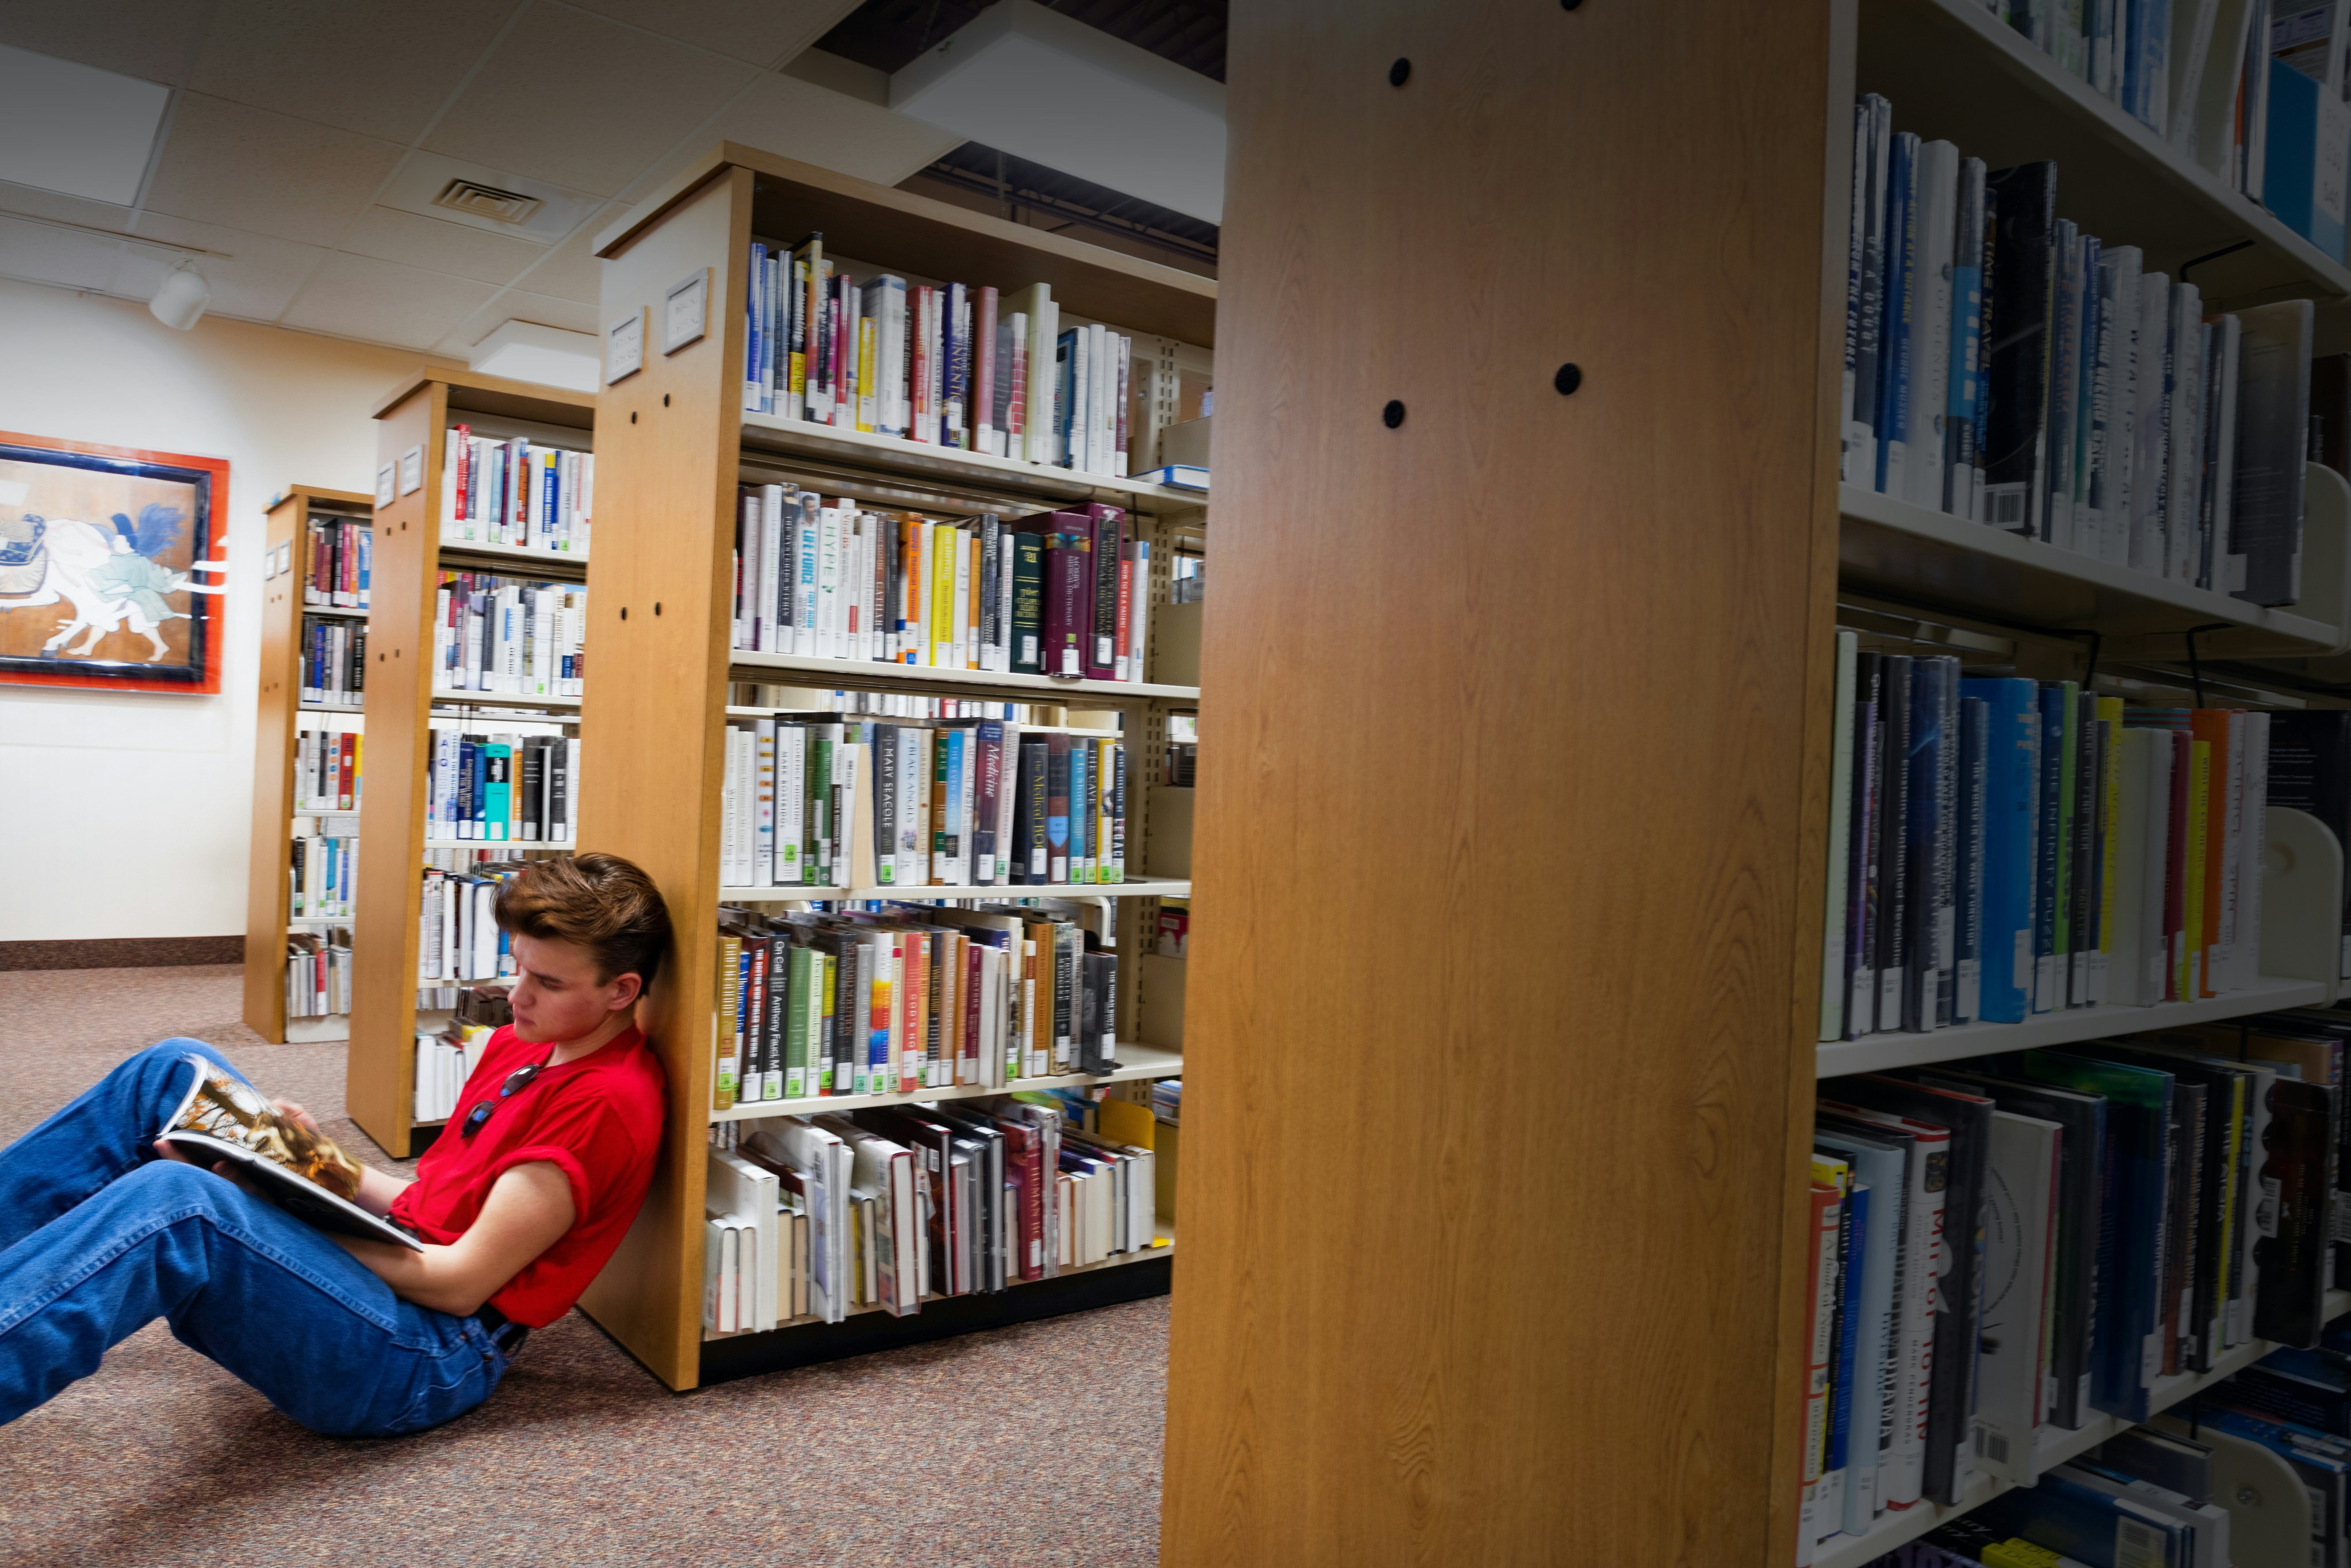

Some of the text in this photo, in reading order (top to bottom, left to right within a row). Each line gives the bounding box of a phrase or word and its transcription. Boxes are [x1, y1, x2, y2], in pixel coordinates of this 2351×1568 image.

[792, 292, 806, 343] Inventing
[1979, 296, 1994, 373] TRAVEL
[1897, 385, 1908, 429] MUSSER
[801, 530, 815, 585] LIFE FORCE
[824, 526, 837, 577] HYPE
[941, 546, 952, 580] thriving
[1073, 556, 1081, 589] MOSBY'S
[1100, 540, 1109, 582] MEDICAL
[1065, 586, 1073, 626] DICTIONARY
[1106, 534, 1116, 637] DORLAND'S ILLUSTRA
[807, 610, 815, 628] ROBB
[882, 748, 894, 827] MARY SEACOLE
[963, 745, 975, 814] MEDICAL FIRSTS
[985, 743, 1000, 798] Medicine
[1075, 762, 1085, 809] In Shock
[1087, 750, 1097, 804] THE CAVE
[1899, 760, 1910, 821] Einstein's
[2050, 754, 2061, 793] THE
[2080, 720, 2094, 850] WHERE TO FIND THEM
[465, 793, 473, 818] WONDERS
[779, 781, 787, 829] BOSTRIDGE
[1113, 818, 1125, 856] LEGAC
[1966, 761, 1981, 946] THE WORLD IN THE WAVE FUNCTION
[2046, 802, 2059, 888] INFINITY
[2198, 836, 2207, 868] HEARS
[1896, 827, 1908, 898] Unfinished
[2076, 889, 2086, 937] PADILLA
[774, 941, 784, 973] On Call
[814, 959, 822, 997] Doctored
[948, 969, 955, 977] IN
[749, 949, 764, 1057] THE DOCTOR WHO FOOLED THE WORLD
[844, 942, 856, 1036] SPLENDID SOLUTION
[931, 965, 941, 1013] TWICE AS HARD
[768, 996, 782, 1032] Anthony
[908, 994, 917, 1048] GOD'S HO
[769, 1034, 780, 1059] Fauci,
[1029, 1167, 1040, 1217] HUMAN
[2218, 1122, 2232, 1222] THE ATOM
[1825, 1239, 1836, 1250] A
[1925, 1208, 1946, 1318] Mirror
[1823, 1257, 1835, 1290] Book
[1817, 1311, 1832, 1355] Noises
[1909, 1339, 1919, 1371] MARK
[1879, 1357, 1901, 1438] DRAMA
[1808, 1405, 1821, 1474] HENDERSON
